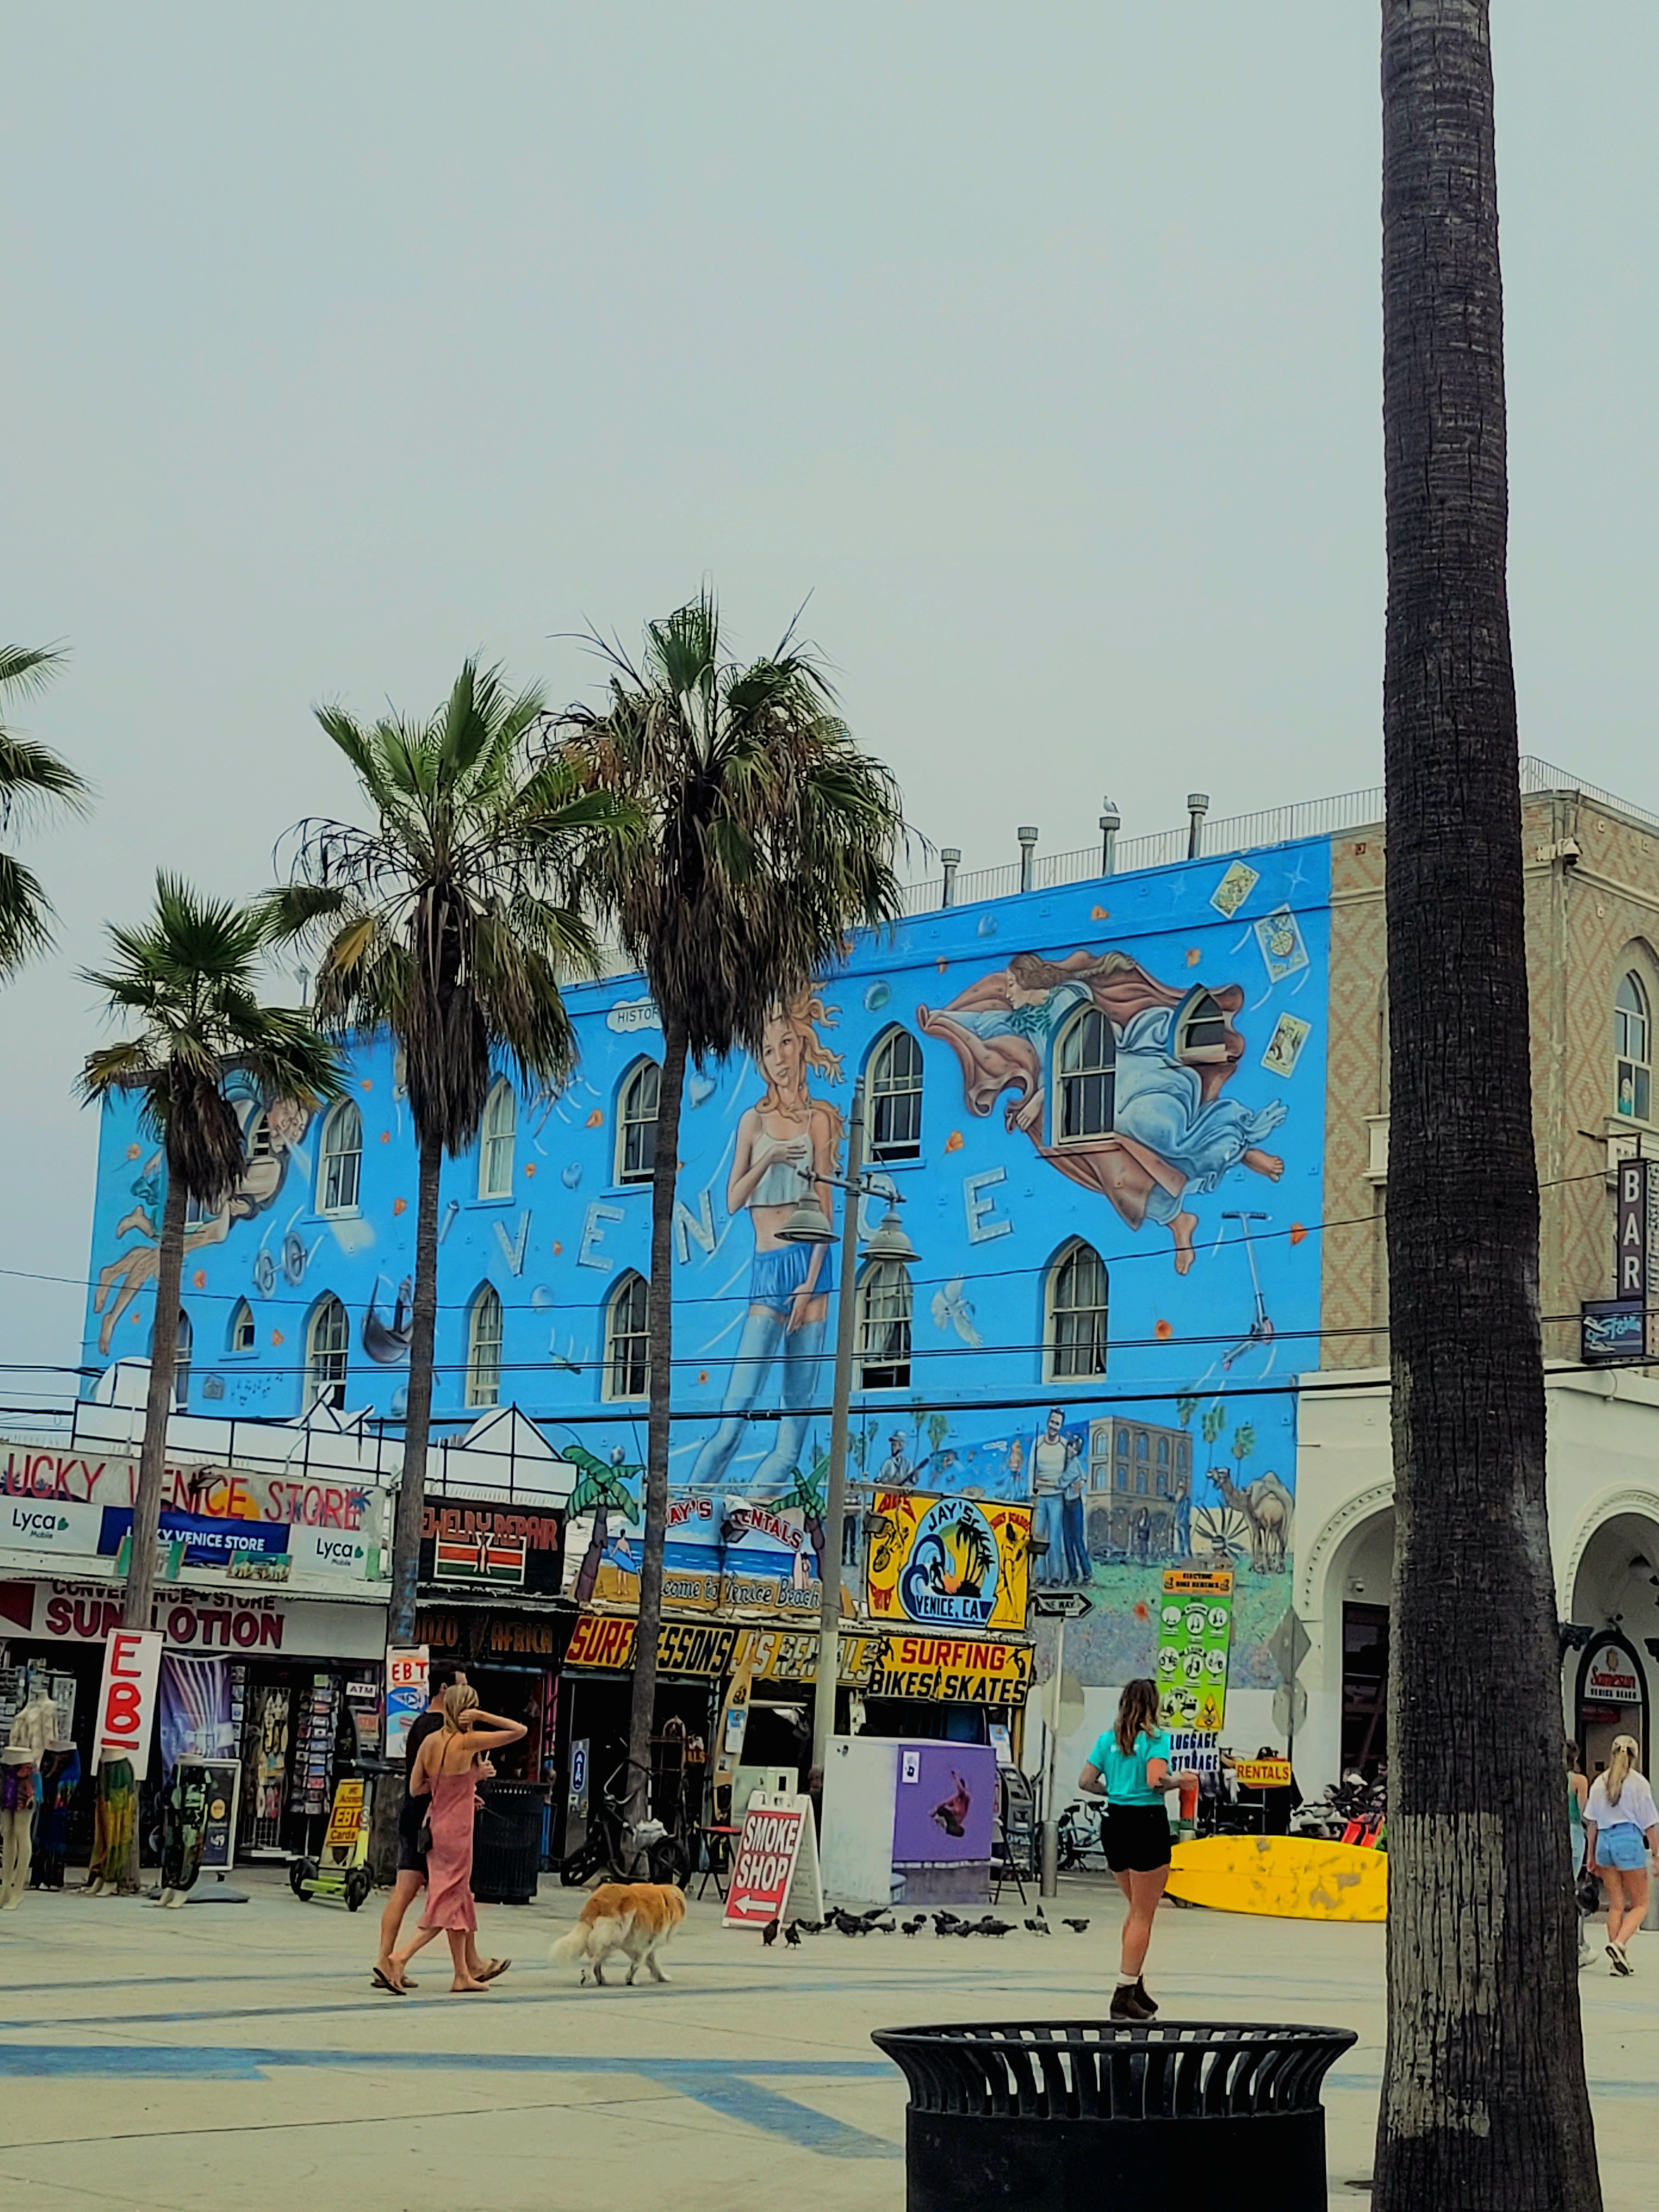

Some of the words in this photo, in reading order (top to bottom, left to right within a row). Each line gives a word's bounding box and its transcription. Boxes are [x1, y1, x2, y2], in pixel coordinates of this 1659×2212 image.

[618, 1007, 659, 1023] HISTOR
[1624, 1169, 1640, 1290] BAR
[5, 1453, 106, 1503] UCKY
[264, 1481, 360, 1531] STORE
[13, 1508, 56, 1531] Lyca
[664, 1498, 712, 1527] AY'S
[928, 1502, 974, 1532] JAY'S
[175, 1530, 222, 1547] VENICE
[224, 1536, 264, 1551] STORE
[420, 1506, 492, 1544] EWELRY
[494, 1513, 558, 1551] REPAIR
[317, 1538, 353, 1559] Lyca
[661, 1579, 701, 1600] come
[725, 1572, 772, 1606] Venice
[775, 1575, 820, 1610] Beach
[46, 1597, 124, 1638] SUN
[963, 1601, 978, 1618] CA
[490, 1621, 553, 1654] AFRICA
[567, 1618, 635, 1664] SURF
[771, 1635, 879, 1682] RENALS
[901, 1639, 1006, 1671] SURFING
[392, 1662, 428, 1681] EBT
[869, 1670, 933, 1697] BIKES
[943, 1674, 1027, 1703] SKATES
[349, 1686, 374, 1694] ATM
[1170, 1732, 1218, 1750] LUGGAGE
[1171, 1754, 1218, 1771] STORAGE
[1237, 1764, 1290, 1781] RENTALS
[335, 1808, 361, 1826] EBT
[743, 1815, 799, 1855] SMOKE
[736, 1852, 789, 1892] SHOP
